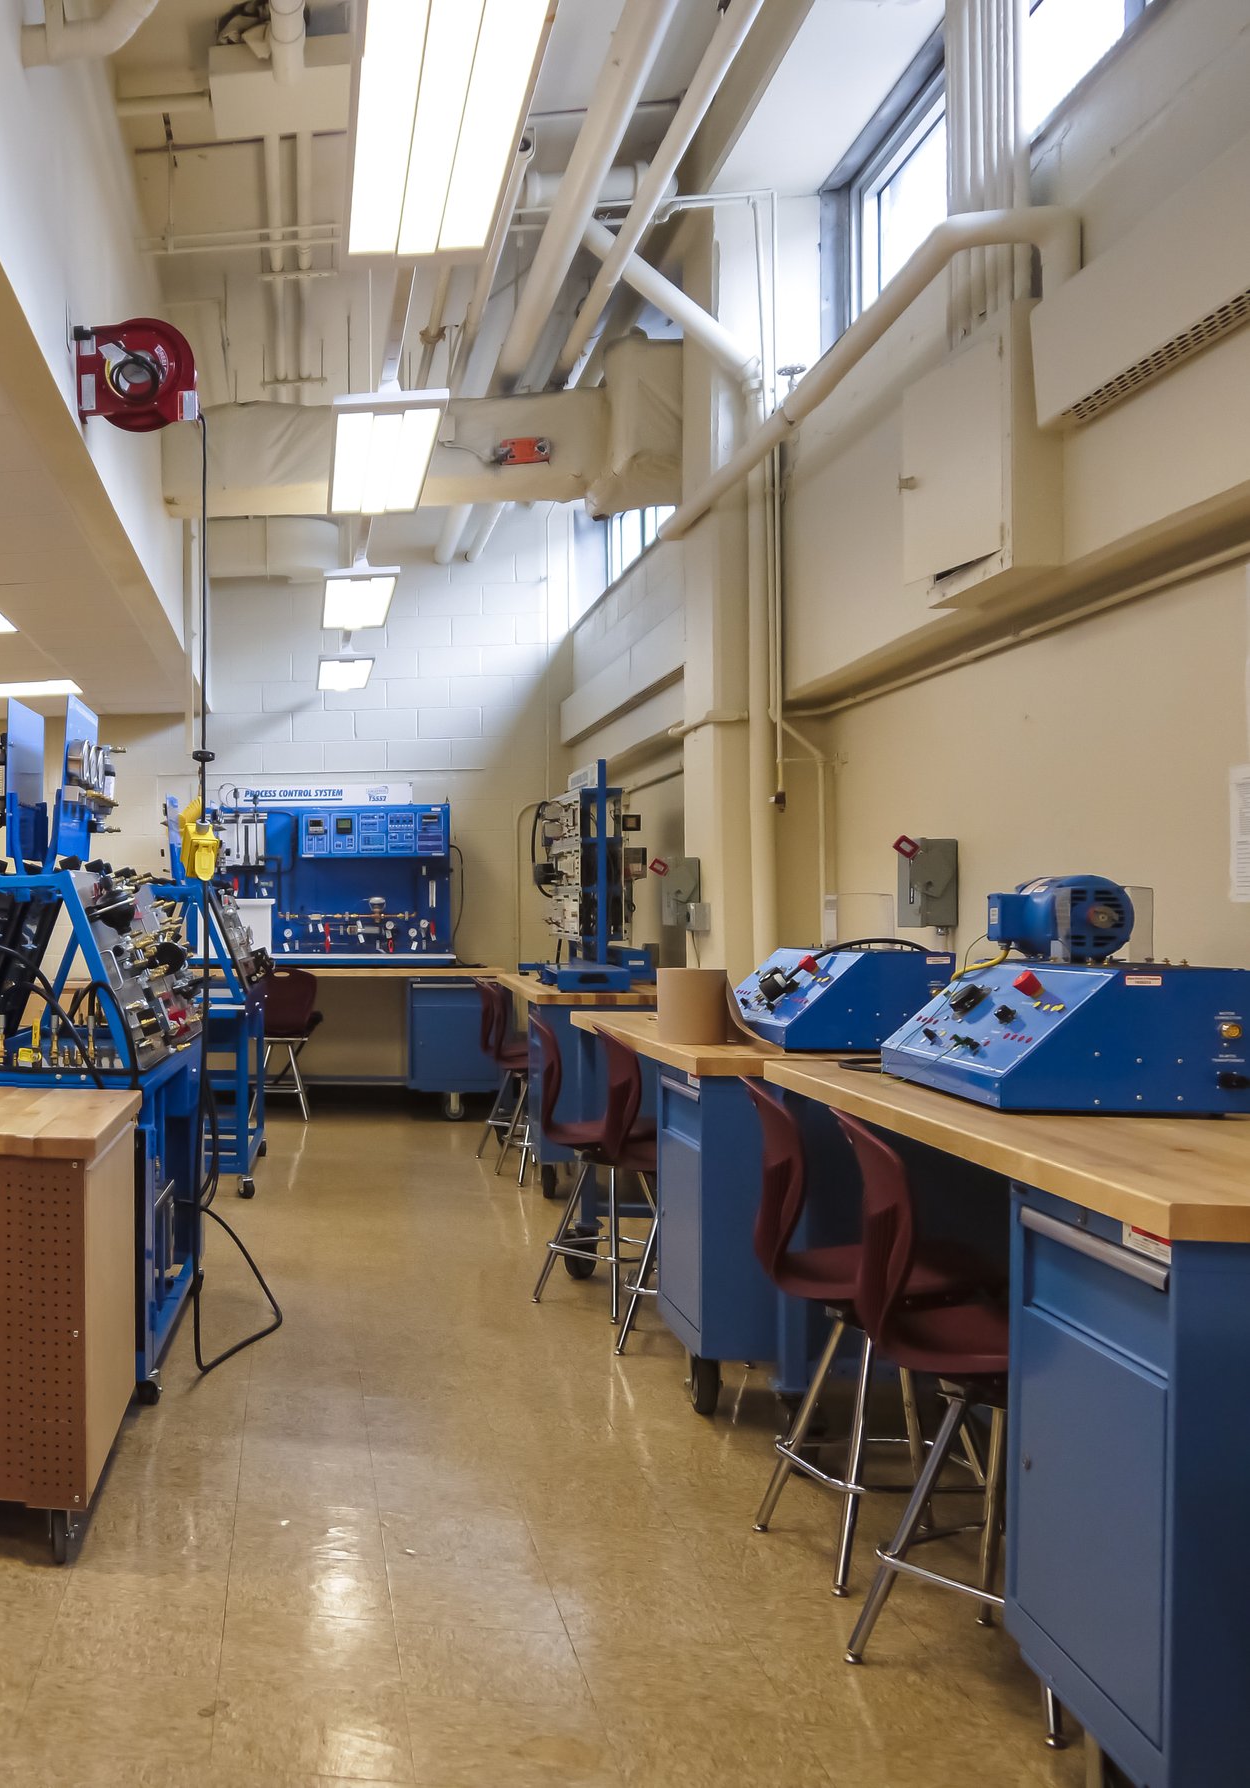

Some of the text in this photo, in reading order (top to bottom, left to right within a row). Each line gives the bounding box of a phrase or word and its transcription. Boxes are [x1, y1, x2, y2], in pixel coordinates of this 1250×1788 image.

[244, 788, 343, 798] PROCESS CONTROL SYSTEM
